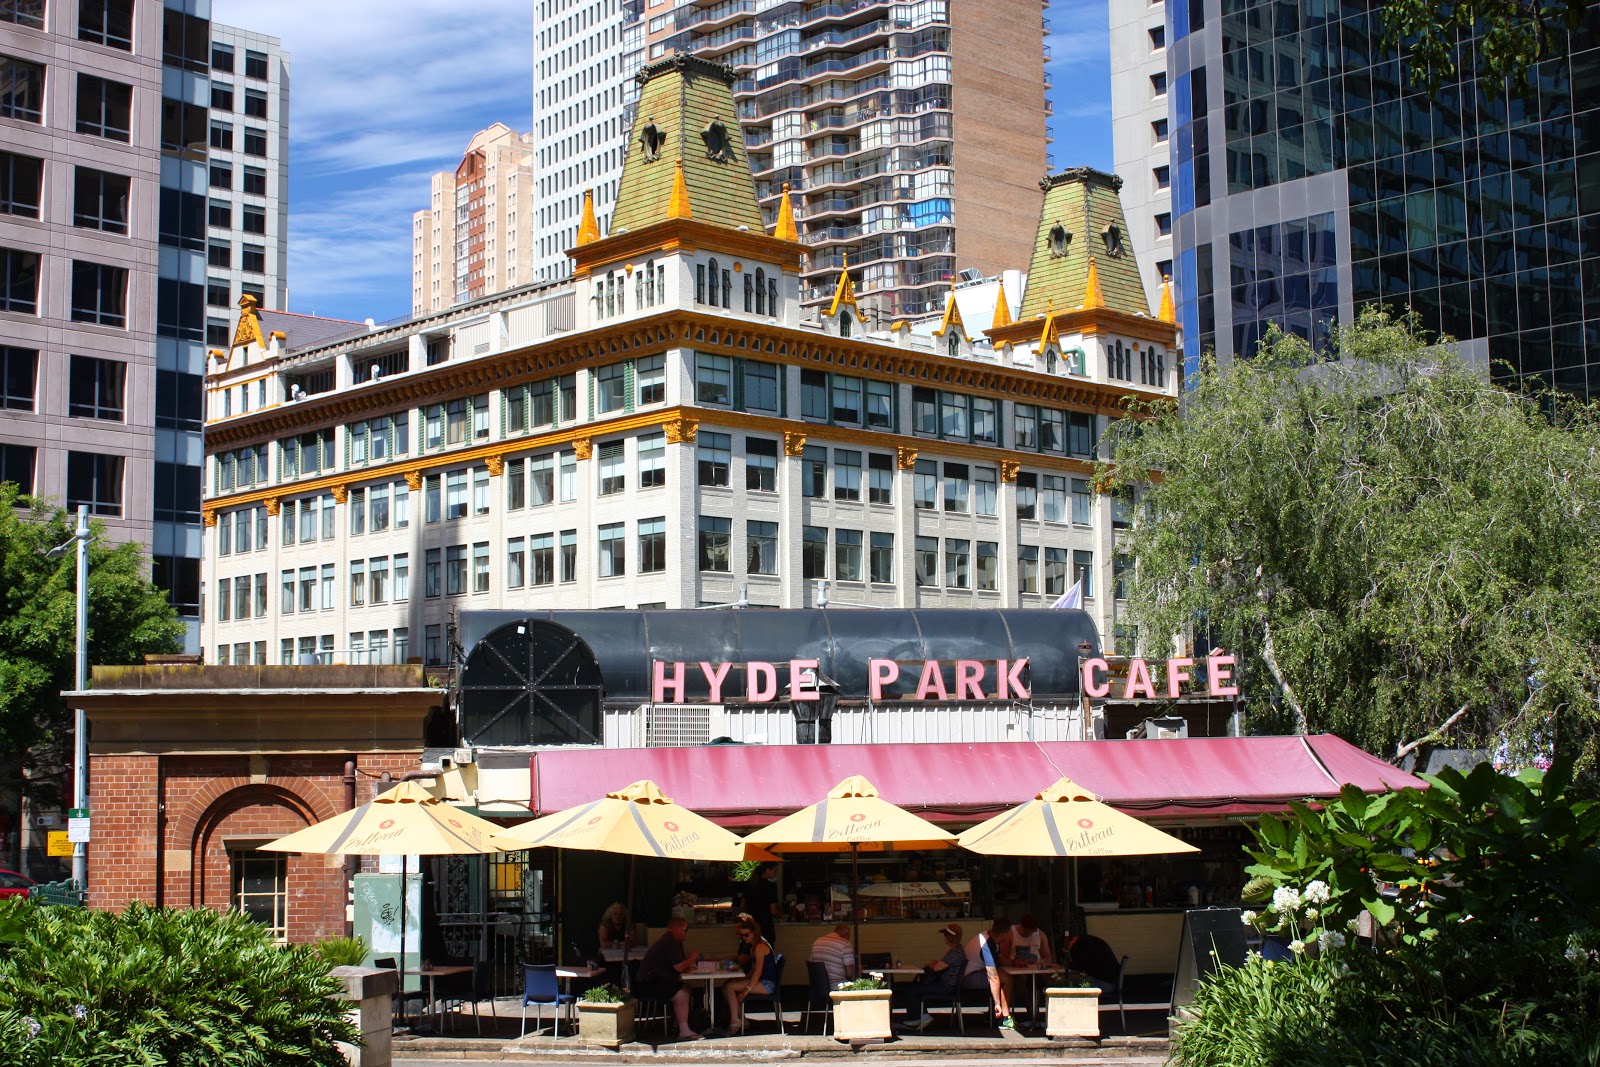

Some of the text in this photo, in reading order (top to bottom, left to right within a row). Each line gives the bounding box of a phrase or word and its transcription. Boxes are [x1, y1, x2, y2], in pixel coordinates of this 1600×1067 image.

[653, 647, 1239, 703] HYDE PARK CAFÉ
[828, 819, 884, 839] Vittoria
[1066, 826, 1116, 852] Vittoria
[660, 831, 701, 853] Vittoria
